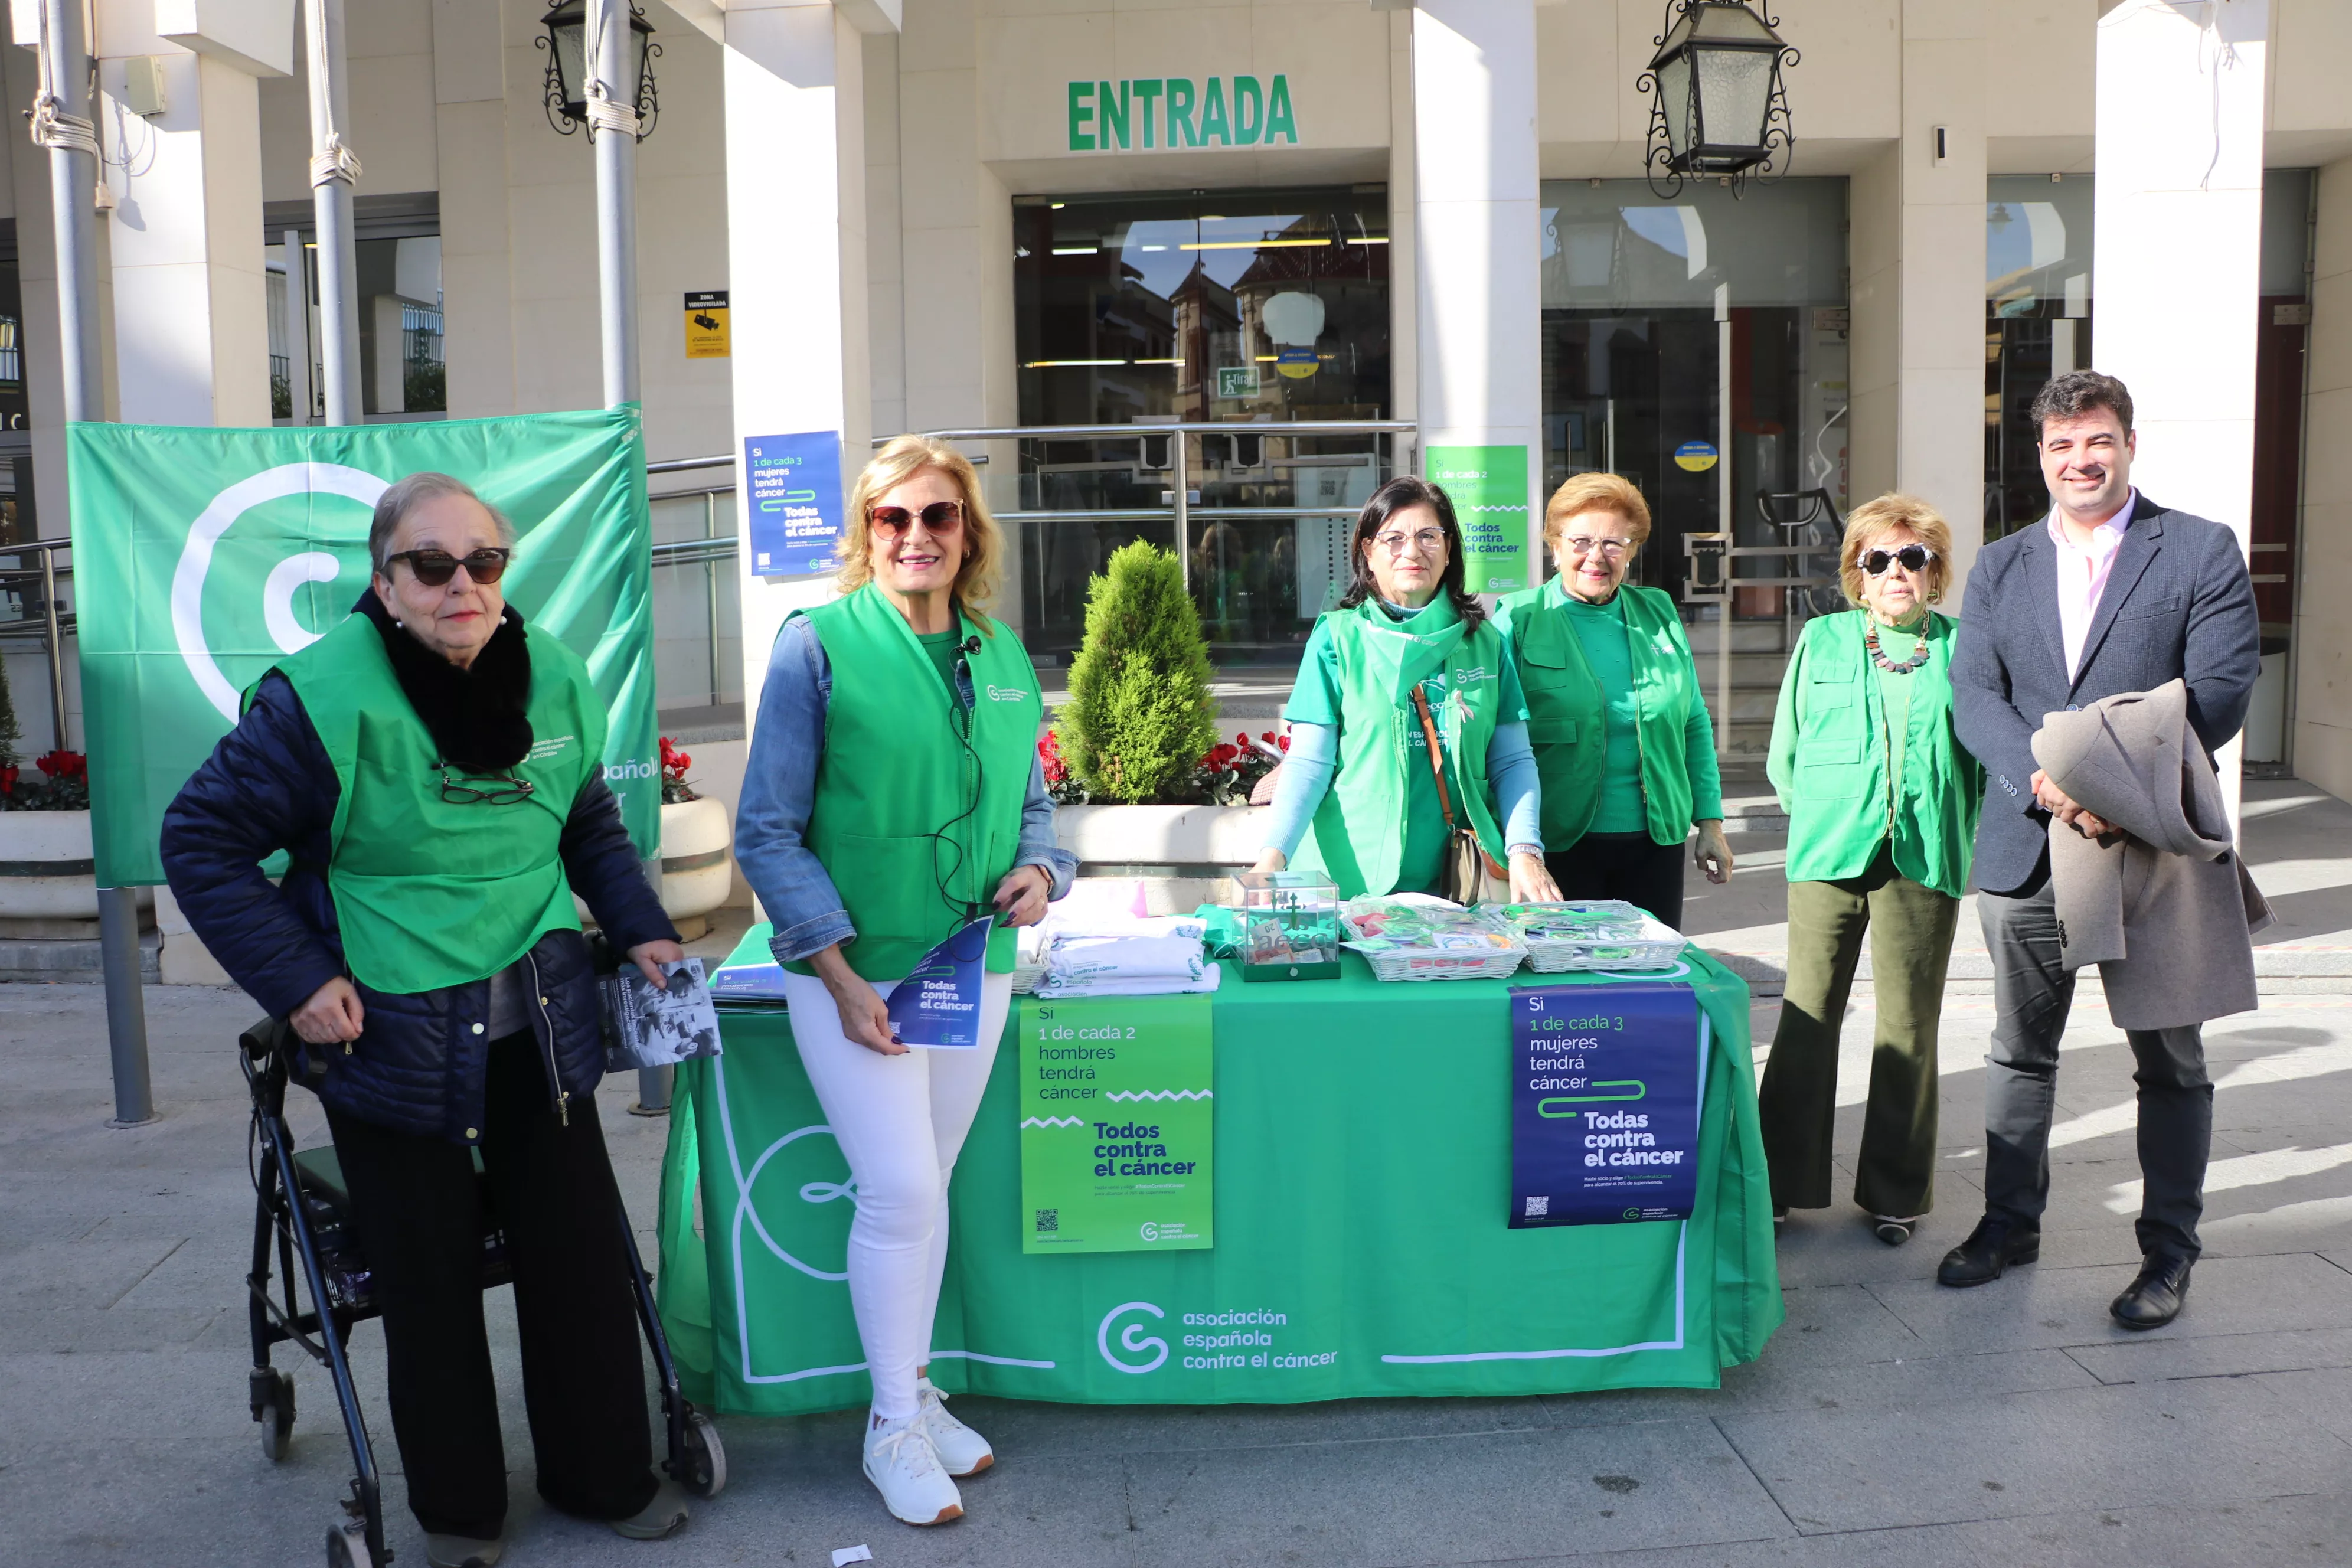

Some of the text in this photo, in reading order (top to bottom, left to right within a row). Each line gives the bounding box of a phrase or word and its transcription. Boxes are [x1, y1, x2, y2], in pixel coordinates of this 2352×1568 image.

[1069, 74, 1298, 151] ENTRADA
[1233, 374, 1253, 385] Tirar
[753, 448, 762, 457] Si
[761, 458, 772, 466] de
[774, 456, 795, 465] cada
[754, 468, 789, 478] mujeres
[755, 478, 783, 487] tendrá
[756, 488, 785, 498] cáncer
[784, 506, 818, 517] Todas
[785, 517, 822, 527] contra
[1465, 522, 1500, 532] Todos
[785, 525, 837, 537] el cáncer
[1465, 533, 1503, 543] contra
[1465, 544, 1519, 553] el cáncer
[1258, 933, 1327, 950] aecc
[923, 981, 956, 990] Todas
[921, 991, 959, 1001] contra
[626, 989, 636, 1018] pacientes
[920, 1000, 974, 1011] el cáncer
[1529, 997, 1544, 1011] Si
[621, 992, 632, 1033] investigación
[1039, 1007, 1053, 1019] Si
[1530, 1014, 1623, 1031] 1 de cada 3
[1039, 1025, 1135, 1040] 1 de cada 2
[1530, 1035, 1598, 1053] mujeres
[1040, 1046, 1115, 1060] hombres
[1530, 1054, 1585, 1070] tendrá
[1039, 1065, 1095, 1079] tendrá
[1530, 1074, 1587, 1090] cáncer
[1040, 1085, 1098, 1099] cáncer
[1584, 1110, 1648, 1129] Todas
[1093, 1122, 1159, 1139] Todos
[1584, 1130, 1655, 1148] contra
[1094, 1141, 1167, 1158] contra
[1584, 1148, 1684, 1167] el cáncer
[1094, 1159, 1196, 1176] el cáncer
[1183, 1308, 1287, 1326] asociación
[1183, 1329, 1272, 1351] española
[1183, 1351, 1338, 1369] contra el cáncer
